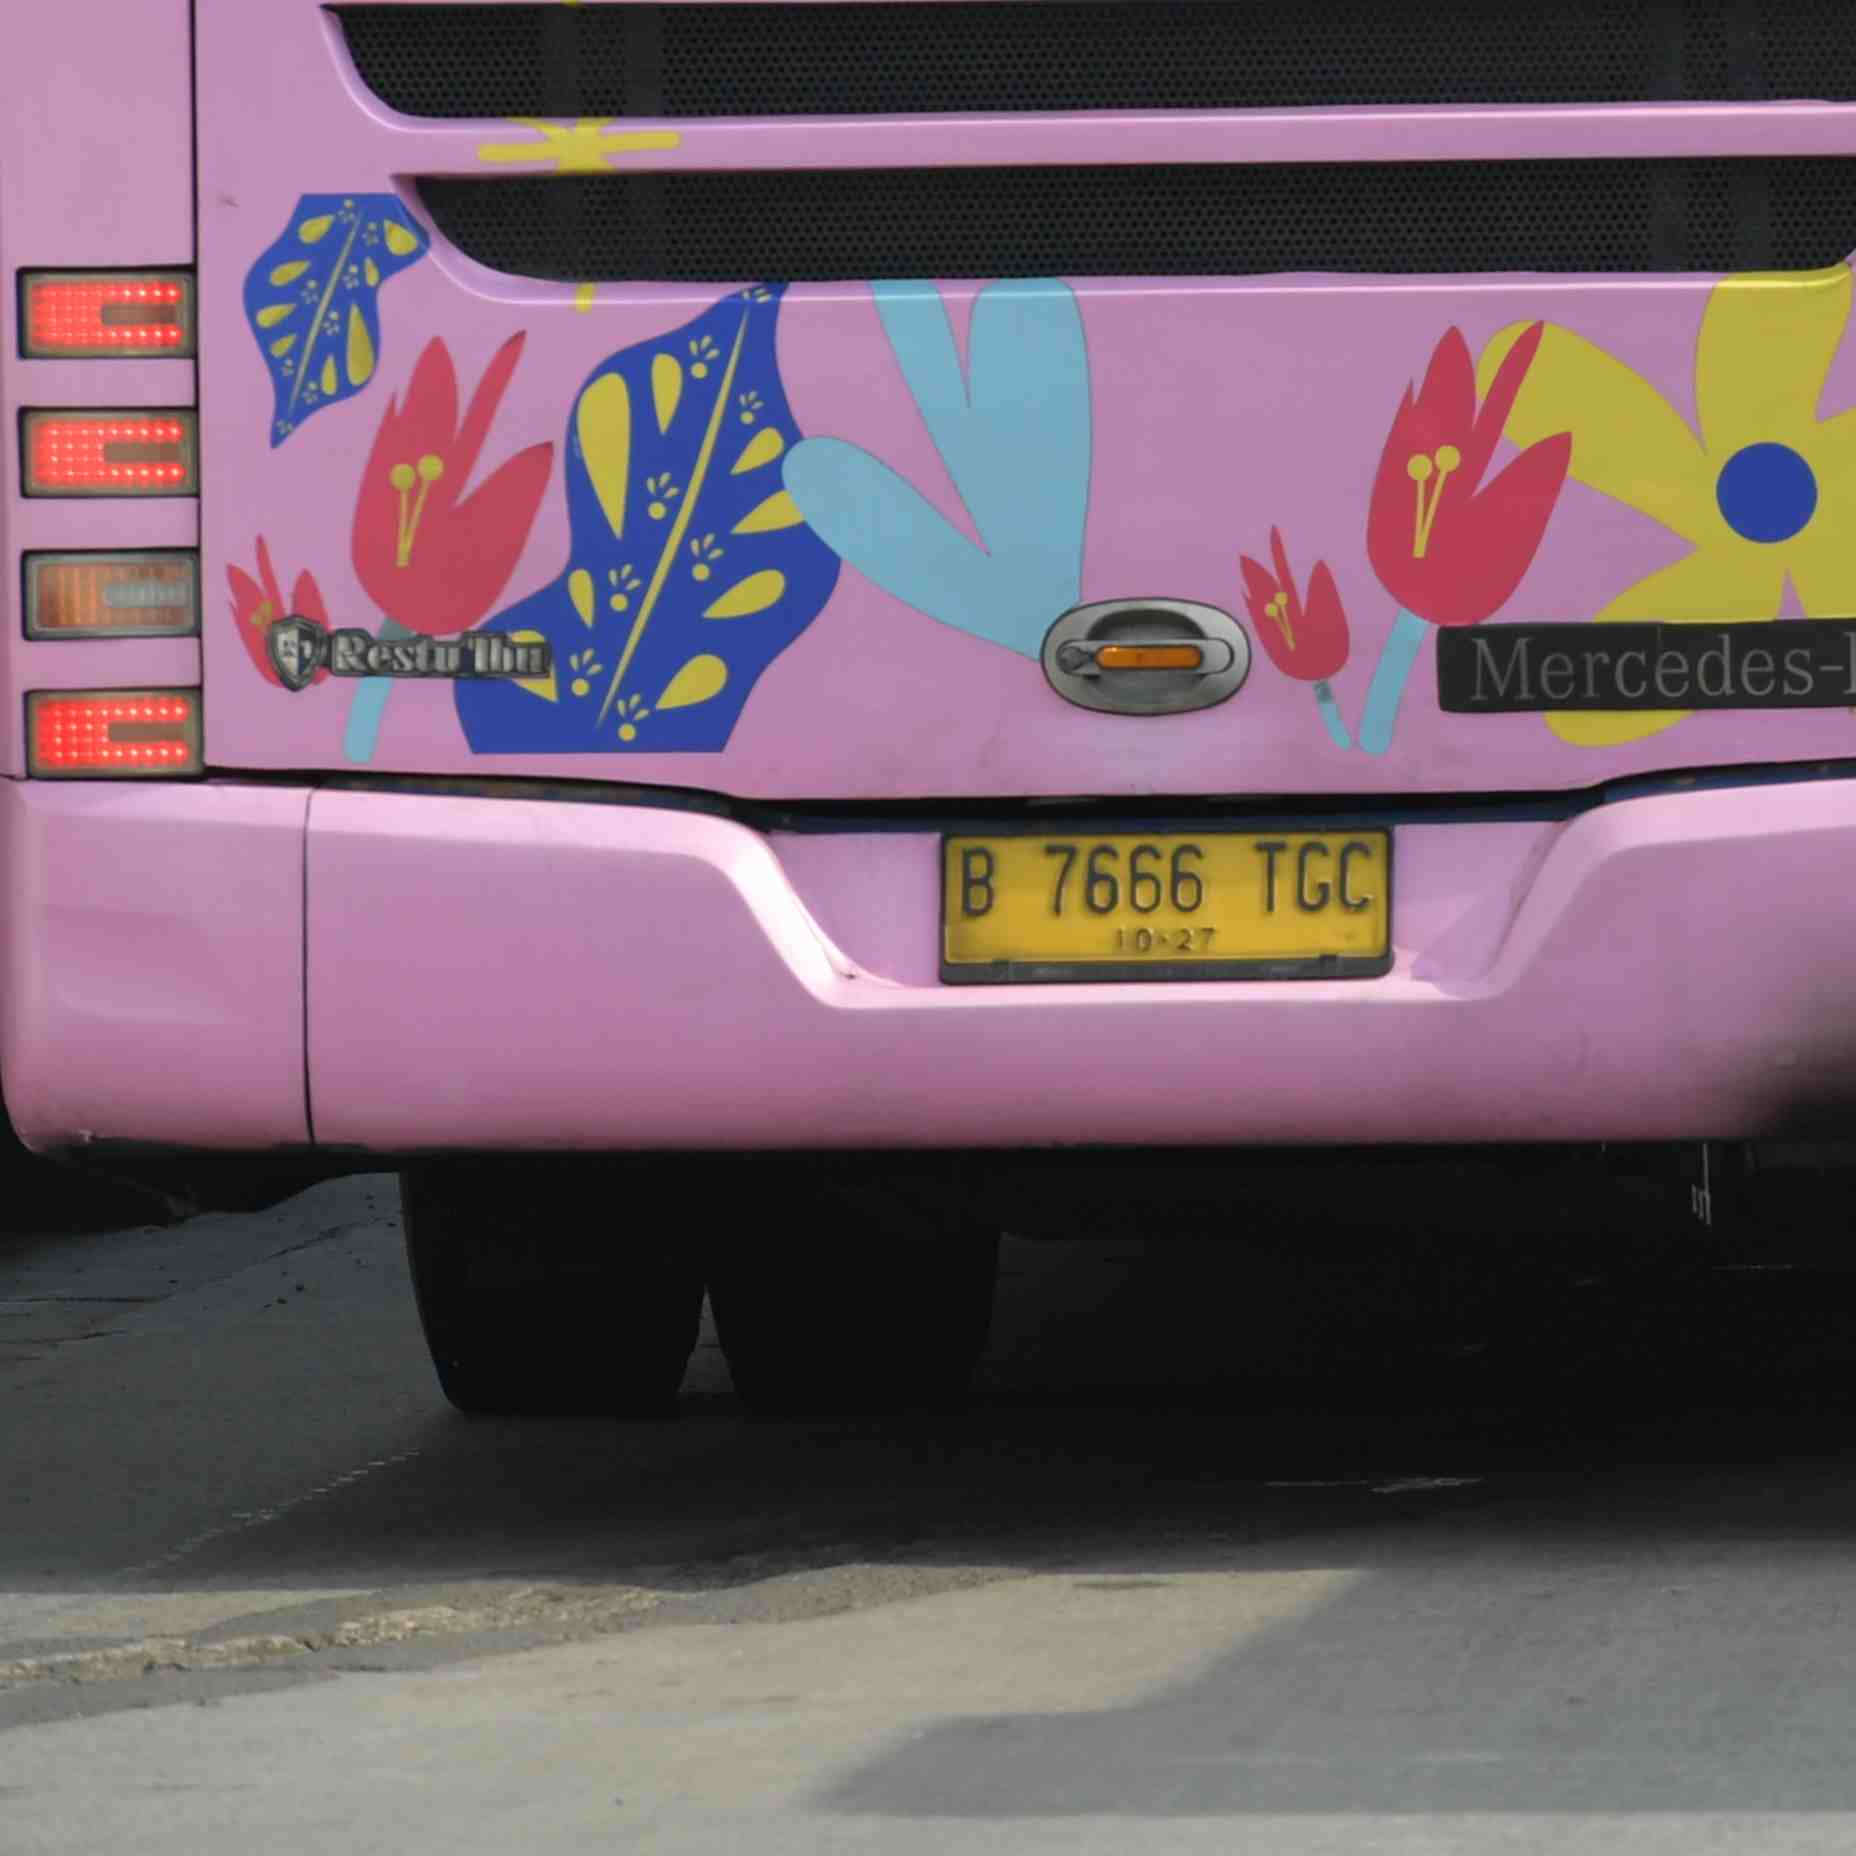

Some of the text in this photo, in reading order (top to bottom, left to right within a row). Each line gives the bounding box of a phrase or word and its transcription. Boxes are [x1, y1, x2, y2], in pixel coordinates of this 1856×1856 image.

[330, 632, 463, 673] Restu
[960, 840, 1374, 917] B 7666 TGC
